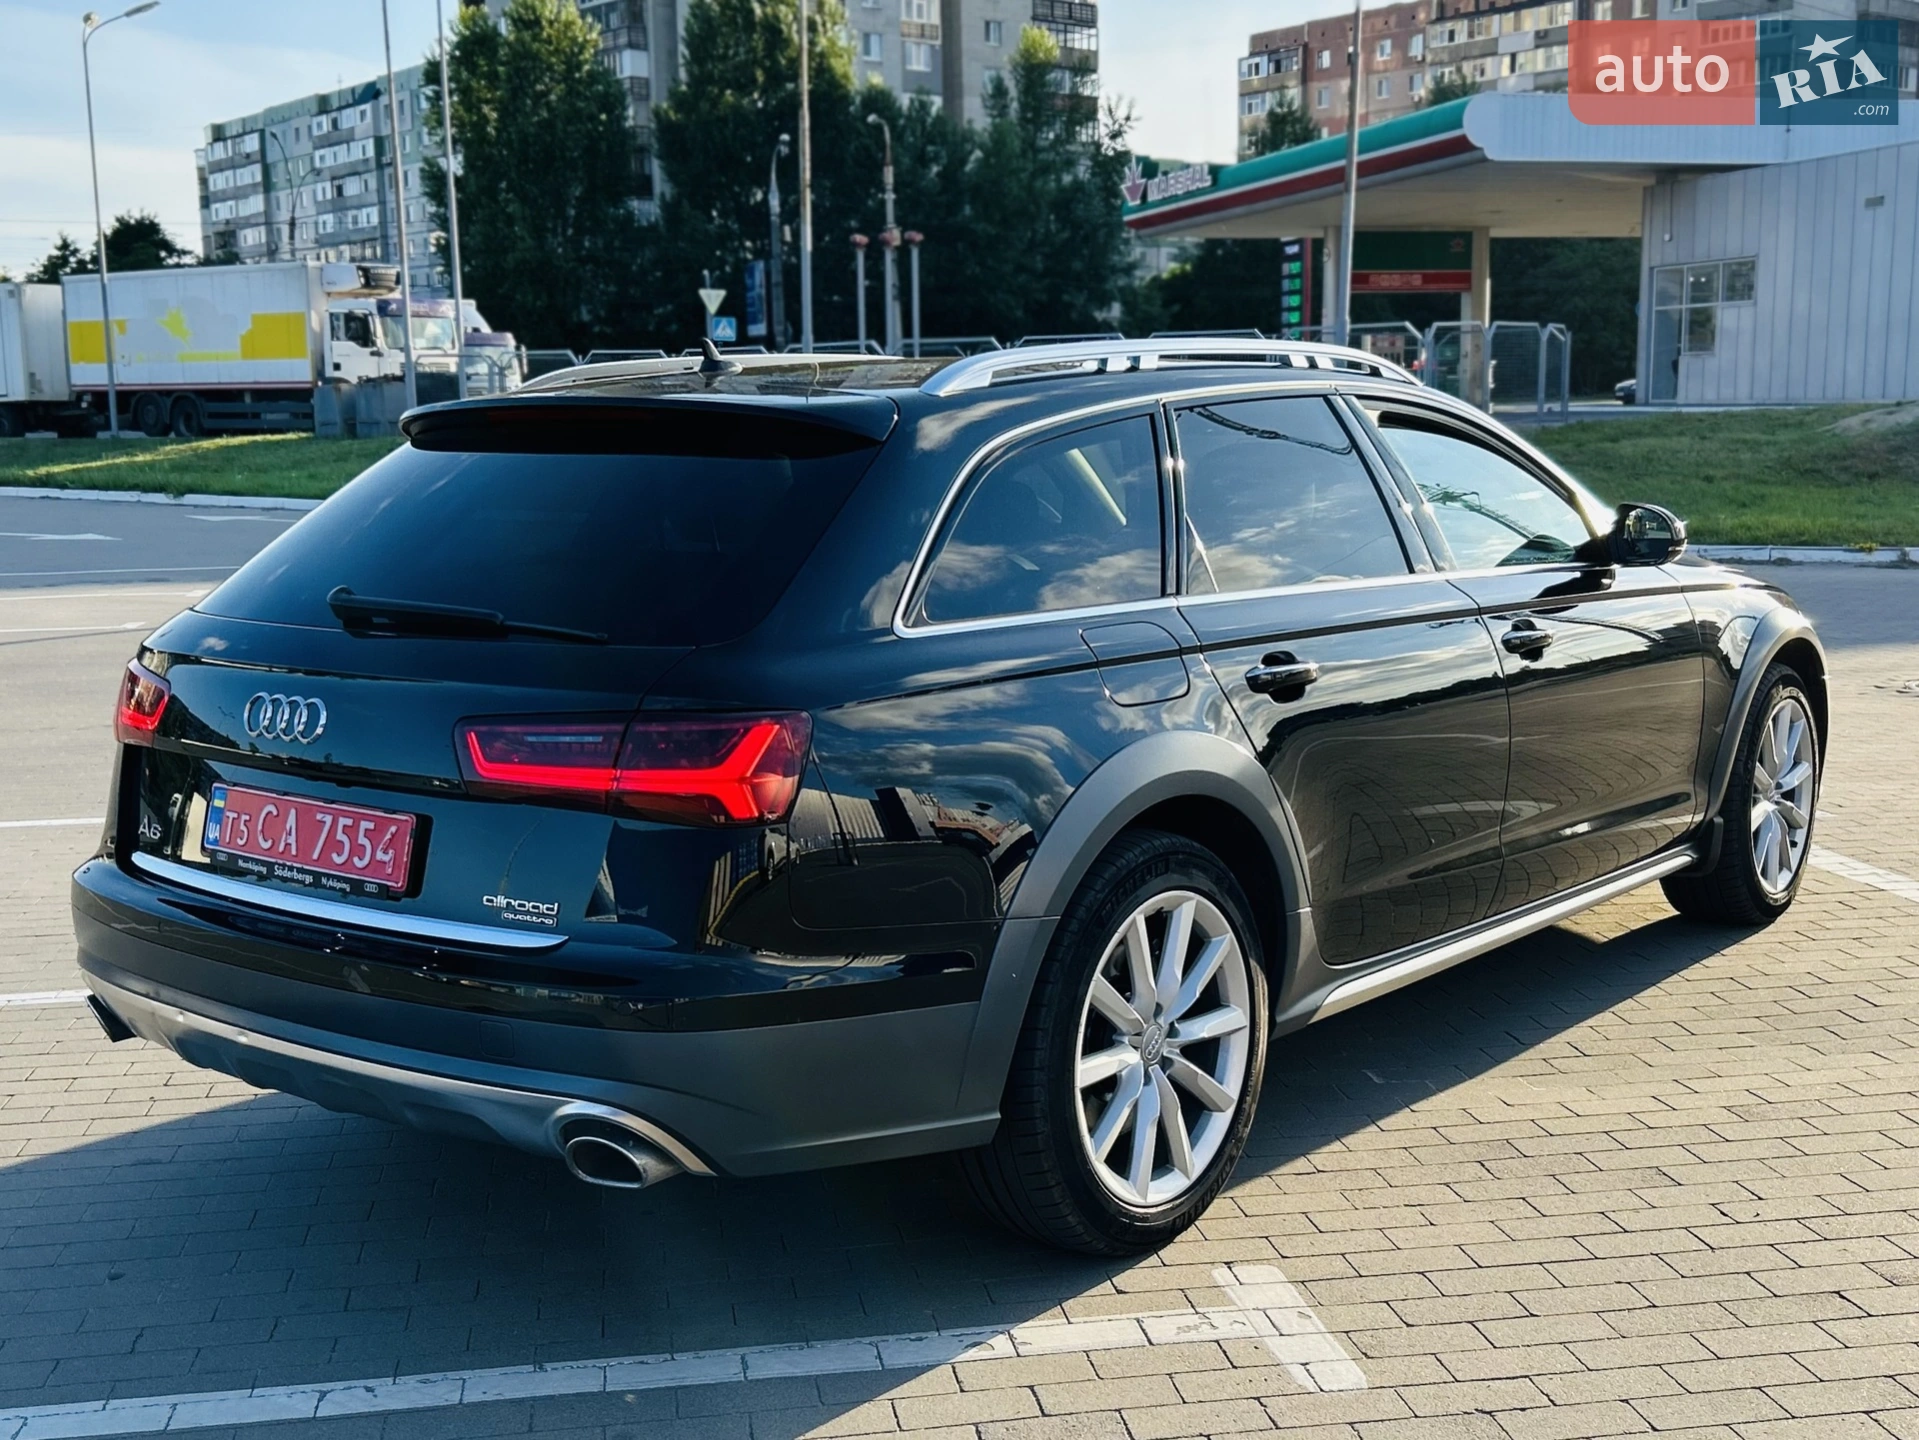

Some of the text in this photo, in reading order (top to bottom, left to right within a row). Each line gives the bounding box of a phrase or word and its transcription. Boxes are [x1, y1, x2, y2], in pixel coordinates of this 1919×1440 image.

[138, 814, 162, 840] A6
[208, 822, 220, 841] UA
[225, 802, 397, 875] T5 CA 7554
[274, 864, 314, 885] Söderbergs
[321, 876, 350, 893] Nyköping
[1099, 860, 1167, 923] MICHELIN
[483, 895, 558, 915] allroad
[503, 912, 553, 925] quattro
